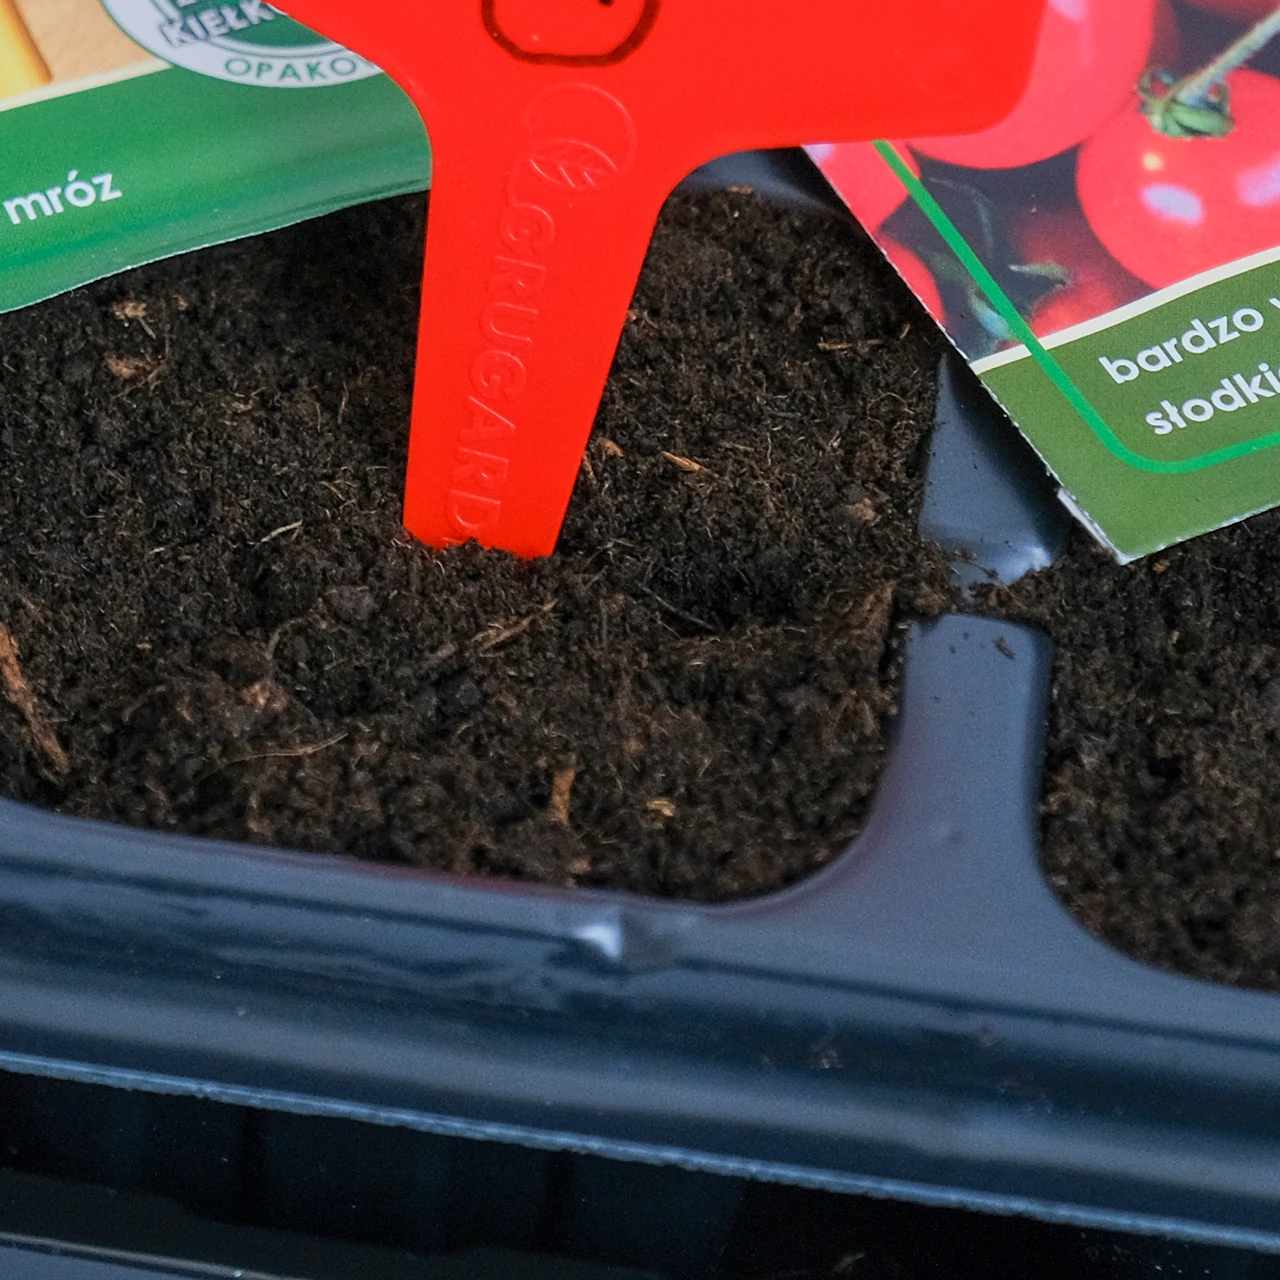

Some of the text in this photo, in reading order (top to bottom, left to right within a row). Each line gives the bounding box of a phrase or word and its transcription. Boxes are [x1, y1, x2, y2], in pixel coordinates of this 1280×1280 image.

[224, 56, 366, 84] OPAKO
[3, 170, 122, 225] mróz
[442, 203, 556, 543] GRUGARD
[1098, 307, 1264, 384] bardzo
[1145, 362, 1280, 435] słodki
